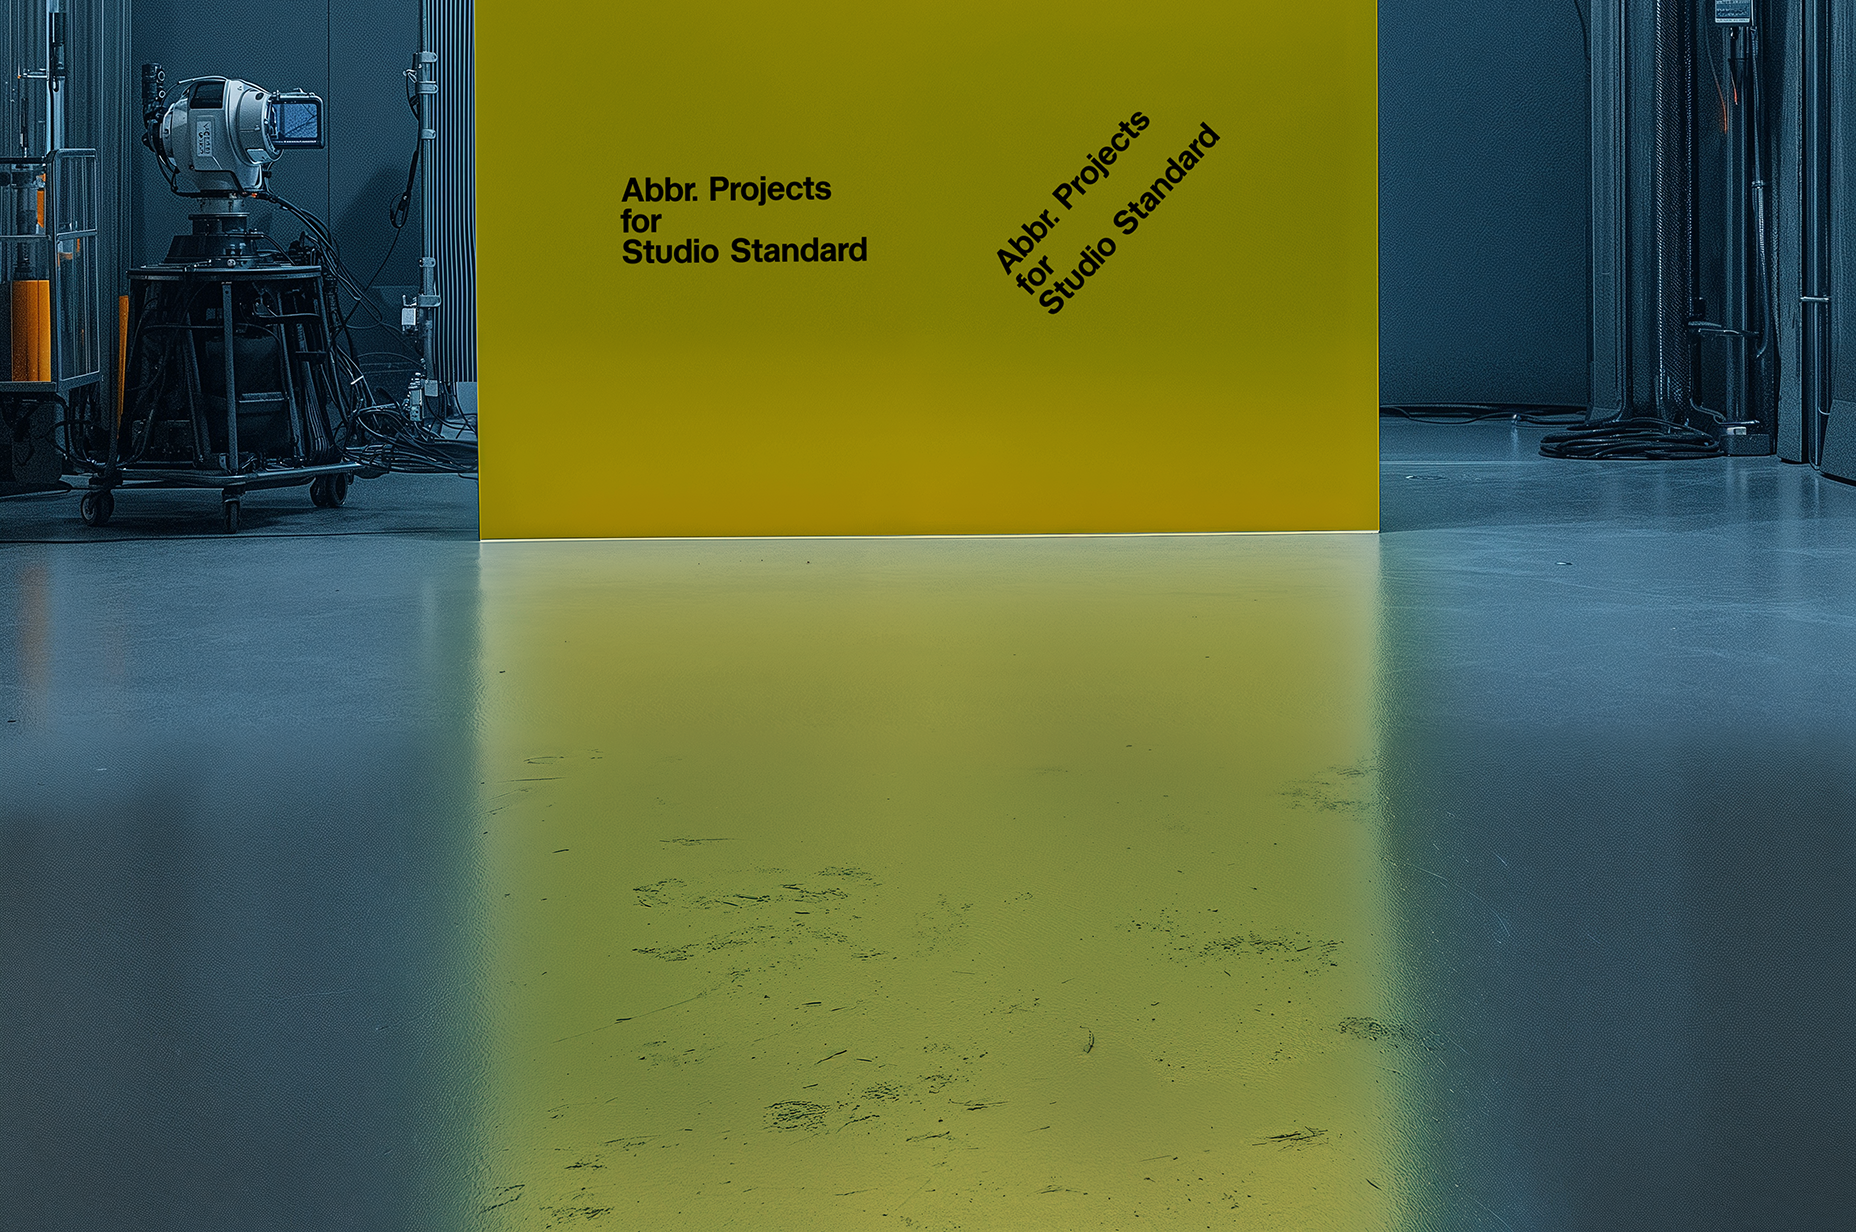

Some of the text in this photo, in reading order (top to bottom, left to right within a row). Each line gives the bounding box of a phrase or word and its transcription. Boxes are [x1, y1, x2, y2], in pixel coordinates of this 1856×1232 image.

[621, 175, 832, 207] Abbr. Projects
[996, 111, 1151, 276] Abbr. Projects
[619, 207, 663, 234] for
[1038, 121, 1221, 315] Studio Standard
[622, 236, 868, 265] Studio Standard
[1015, 254, 1055, 296] for
